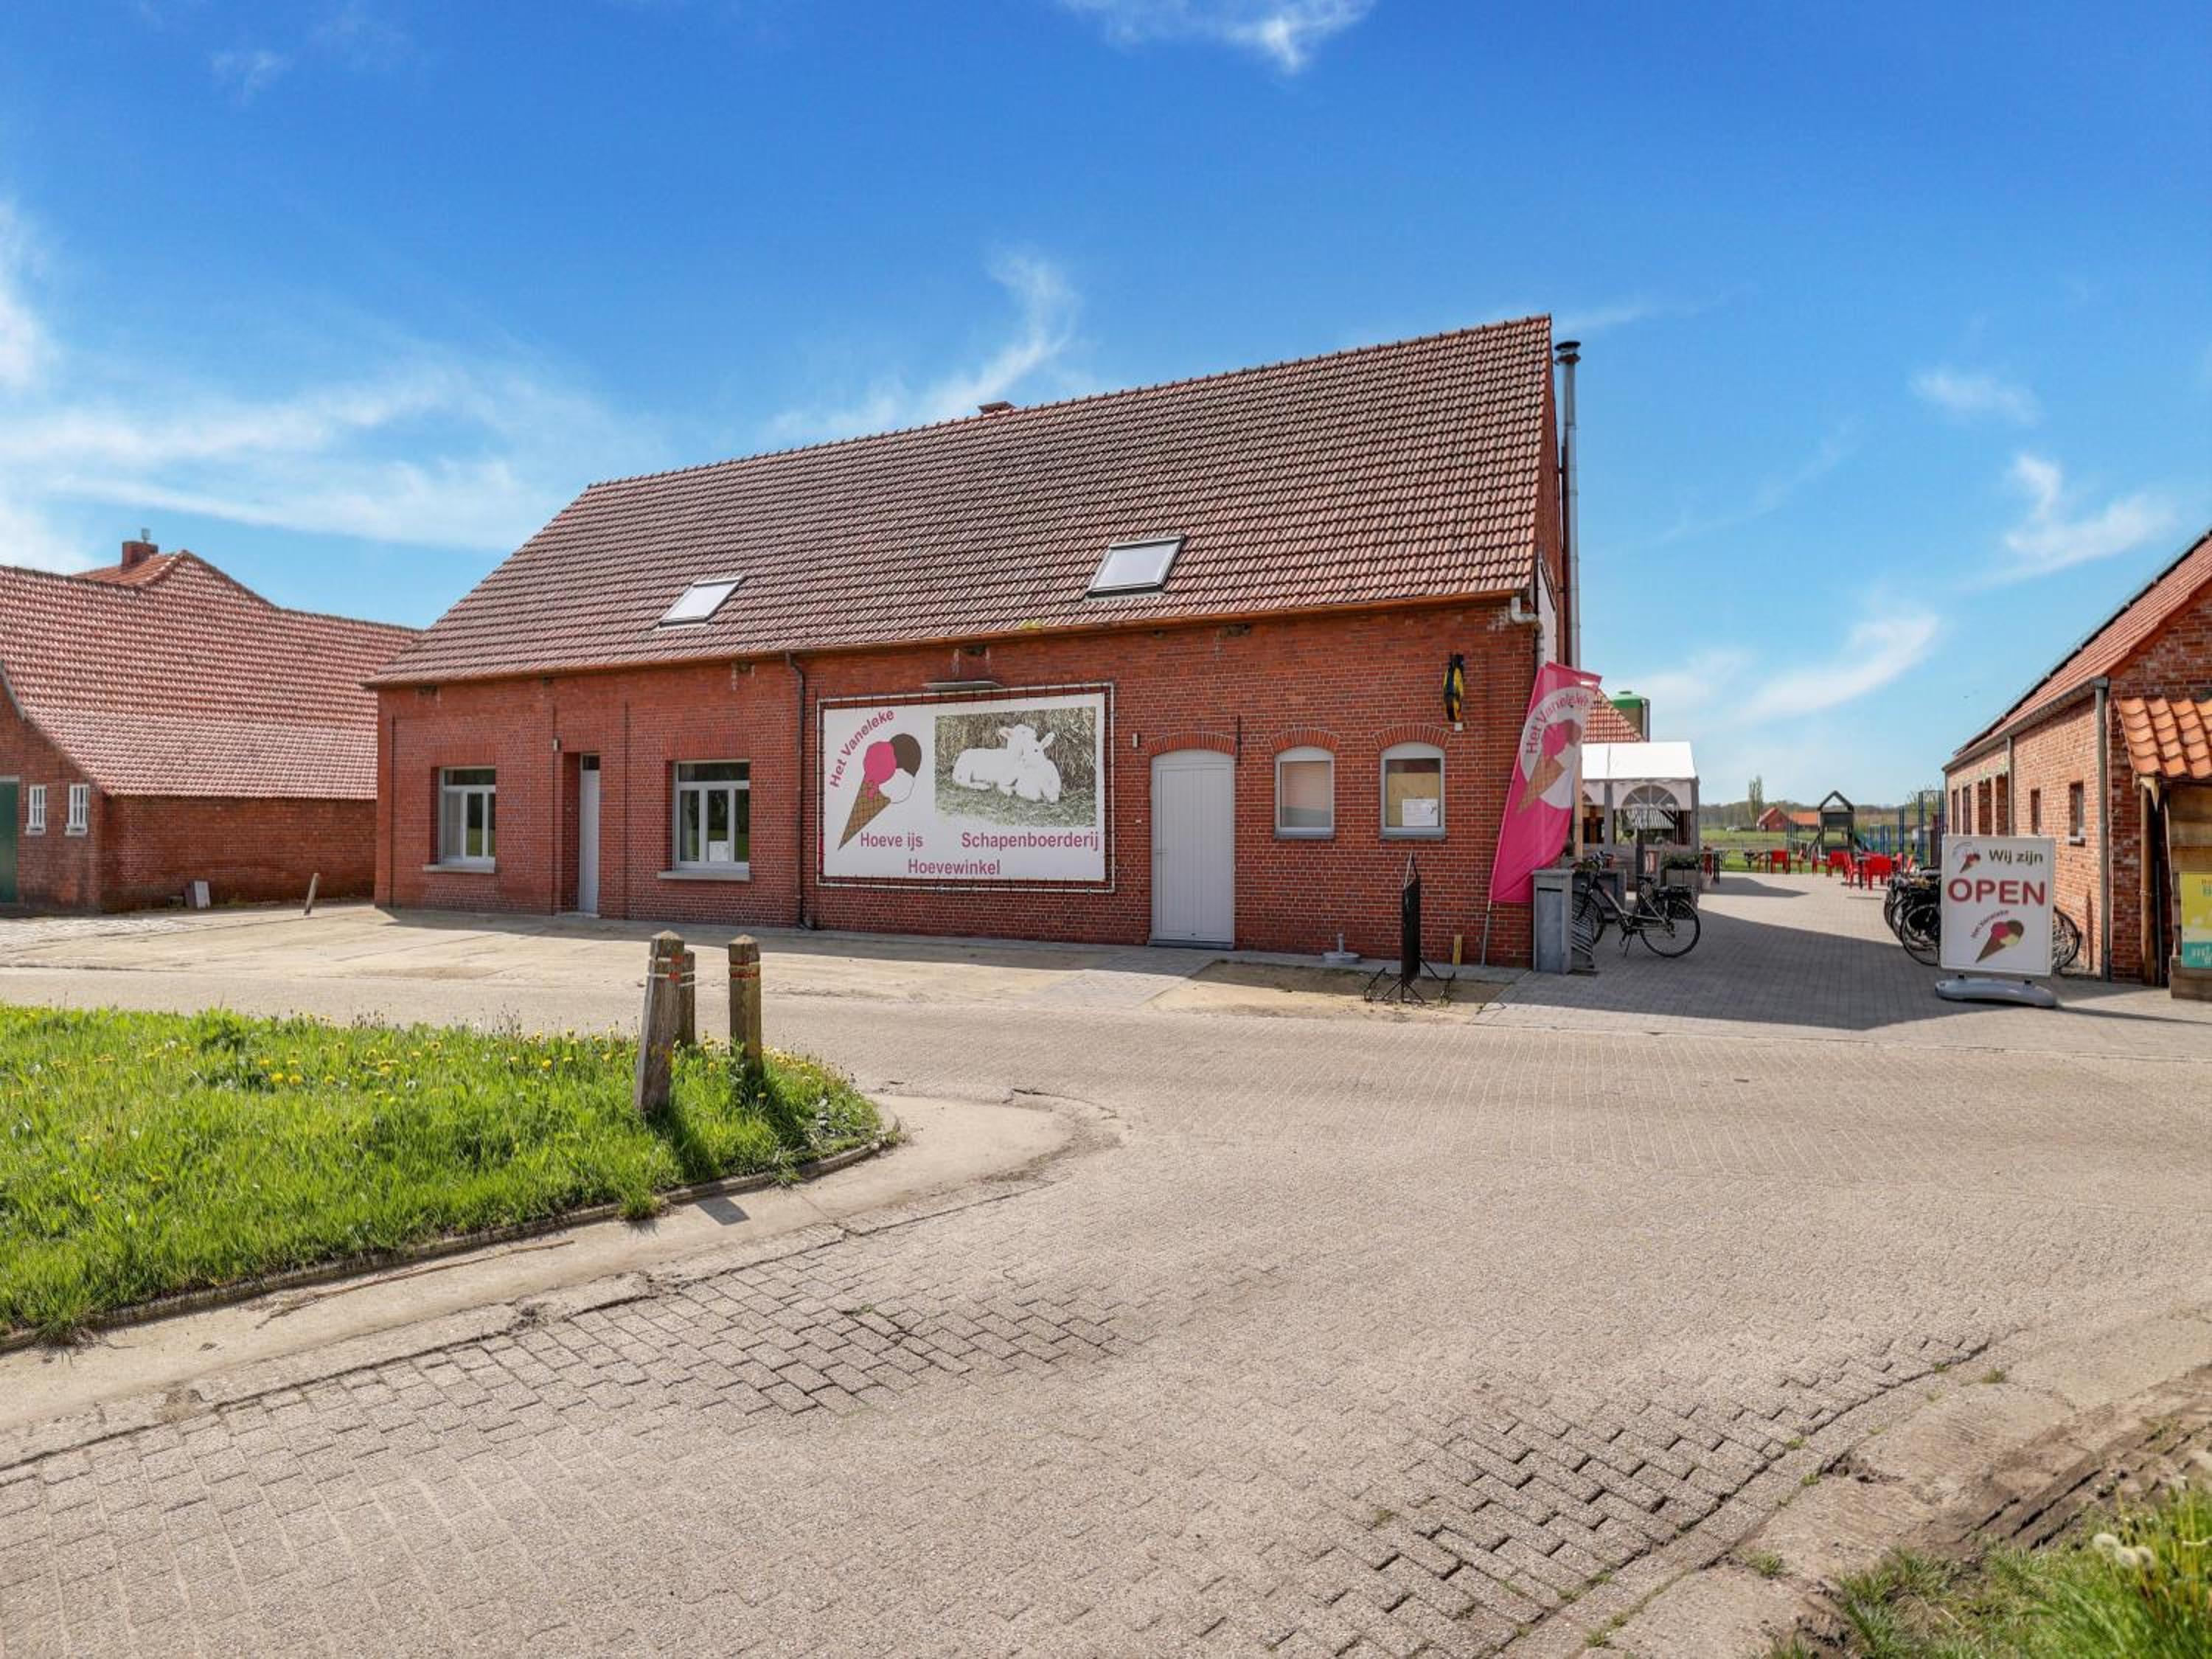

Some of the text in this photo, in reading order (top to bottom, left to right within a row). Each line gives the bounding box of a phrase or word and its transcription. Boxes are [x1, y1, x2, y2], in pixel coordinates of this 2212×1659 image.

[830, 709, 894, 788] Het Vaneleke
[1526, 726, 1541, 754] Het
[860, 832, 923, 851] Hoeve ijs
[961, 832, 1099, 852] Schapenboerderij
[907, 858, 1001, 876] Hoevewinkel
[1989, 849, 2012, 865] Wij
[2016, 850, 2044, 866] zijn
[1947, 877, 2045, 907] OPEN
